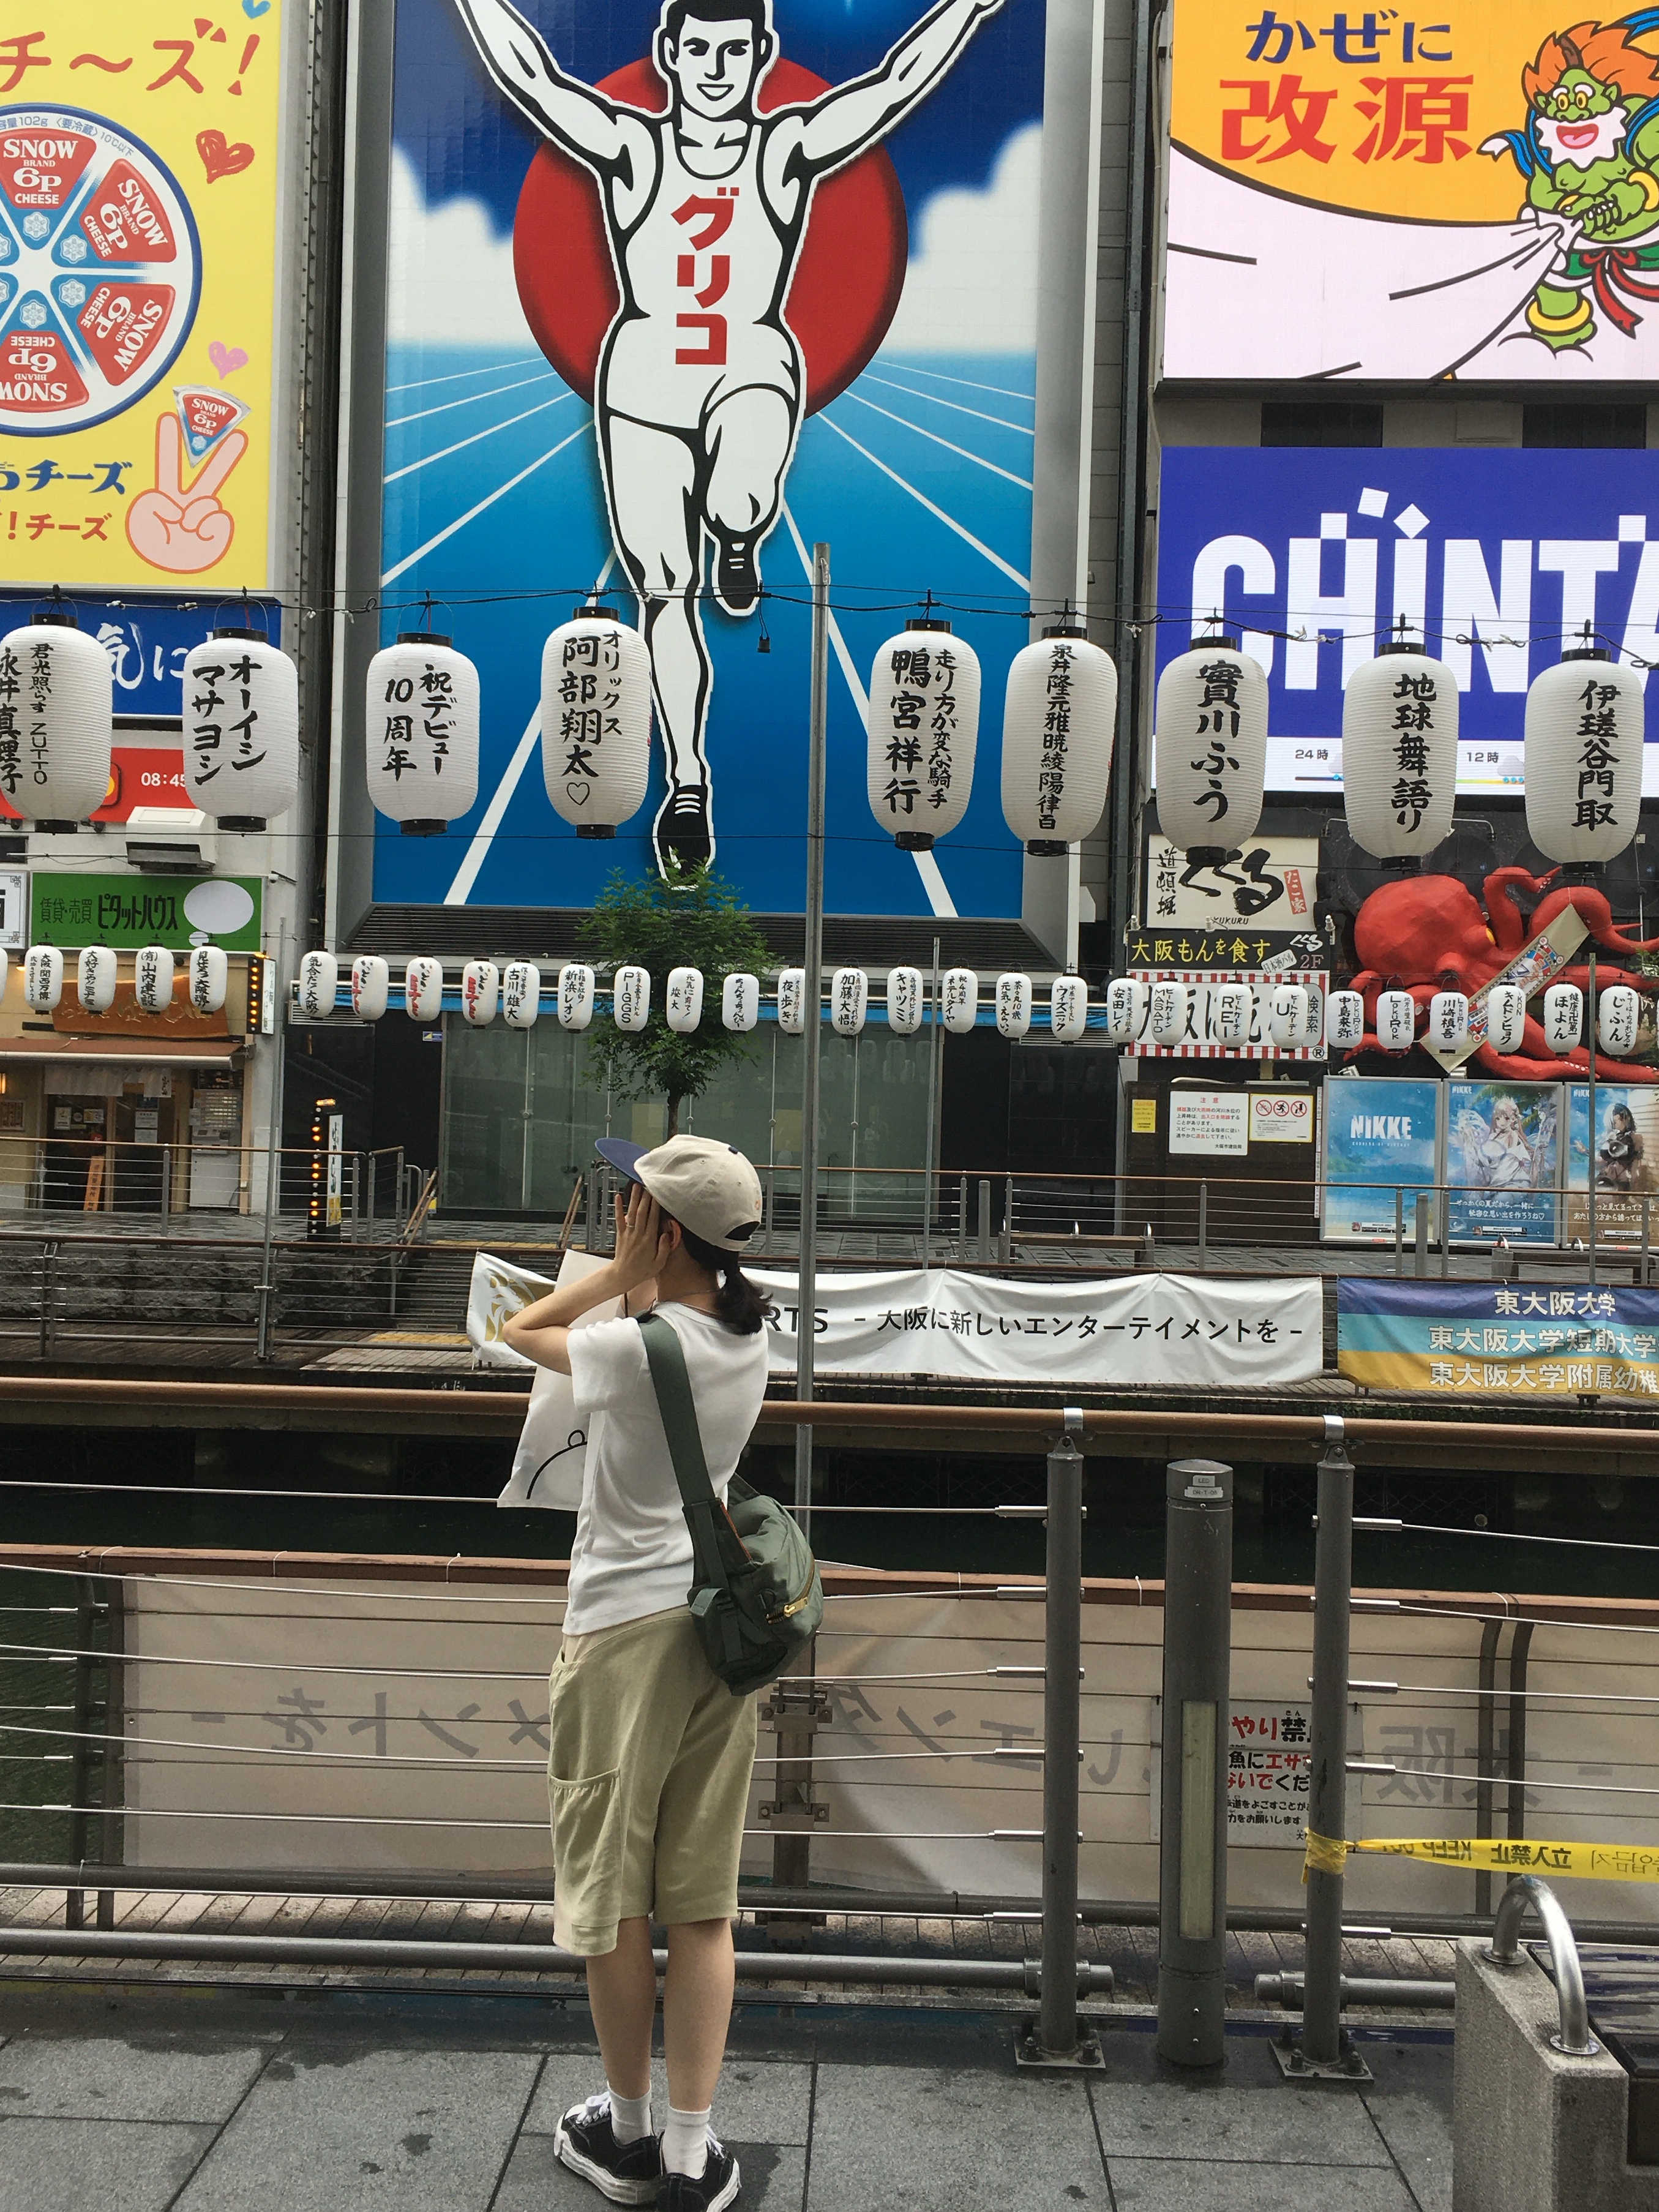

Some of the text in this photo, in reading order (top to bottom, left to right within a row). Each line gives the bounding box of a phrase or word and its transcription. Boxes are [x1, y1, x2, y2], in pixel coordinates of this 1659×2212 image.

[1245, 10, 1453, 64] かぜに
[1219, 73, 1474, 164] 改源
[3, 138, 78, 159] SNOW
[13, 167, 62, 192] 6P
[15, 193, 59, 204] CHEESE
[100, 203, 128, 250] 6P
[117, 178, 168, 246] SNOW
[119, 204, 140, 235] BRAND
[83, 215, 112, 257] CHEESE
[671, 187, 740, 365] グリコ
[83, 287, 111, 329] CHEESE
[95, 296, 132, 339] 6P
[116, 311, 136, 342] BRAND
[10, 336, 55, 348] CHEESE
[113, 299, 163, 372] SNOW
[8, 348, 57, 373] 6P
[14, 373, 47, 381] BRAND
[191, 398, 230, 416] SNOW
[193, 413, 217, 429] 6P
[191, 425, 214, 436] CHEESE
[601, 630, 623, 736] オリックス
[192, 665, 225, 785] マサヨシ
[228, 654, 268, 771] オーイシ
[418, 663, 457, 776] 祝デビュー
[557, 635, 602, 778] 阿部翔太
[926, 648, 959, 809] 走り方が変な騎手
[382, 677, 418, 781] 10周年
[882, 647, 932, 814] 鴨宮祥行
[1390, 672, 1437, 833] 地球舞語り
[1156, 847, 1178, 917] 道頓堀
[98, 893, 179, 931] ピタットハウス
[1131, 938, 1270, 964] 大阪もんを食す
[1300, 954, 1324, 969] 2F
[507, 968, 520, 1020] 古川雄大
[564, 970, 577, 1023] 新浜レオン
[621, 972, 634, 1023] PIGGS
[781, 980, 794, 1024] 夜歩き
[838, 974, 855, 1025] 加藤大悟
[896, 972, 907, 1022] キャツミ
[1112, 987, 1126, 1032] 安田レイ
[1153, 989, 1166, 1033] MASATO
[1276, 1003, 1290, 1016] U
[1221, 996, 1235, 1038] REI
[1500, 991, 1514, 1045] キムドンヒョク
[1553, 996, 1568, 1040] ほよん
[1452, 1085, 1472, 1094] NIKKE
[1350, 1115, 1412, 1140] NIKKE
[1494, 1291, 1616, 1317] 東大阪大学
[1232, 1716, 1311, 1742] やり禁
